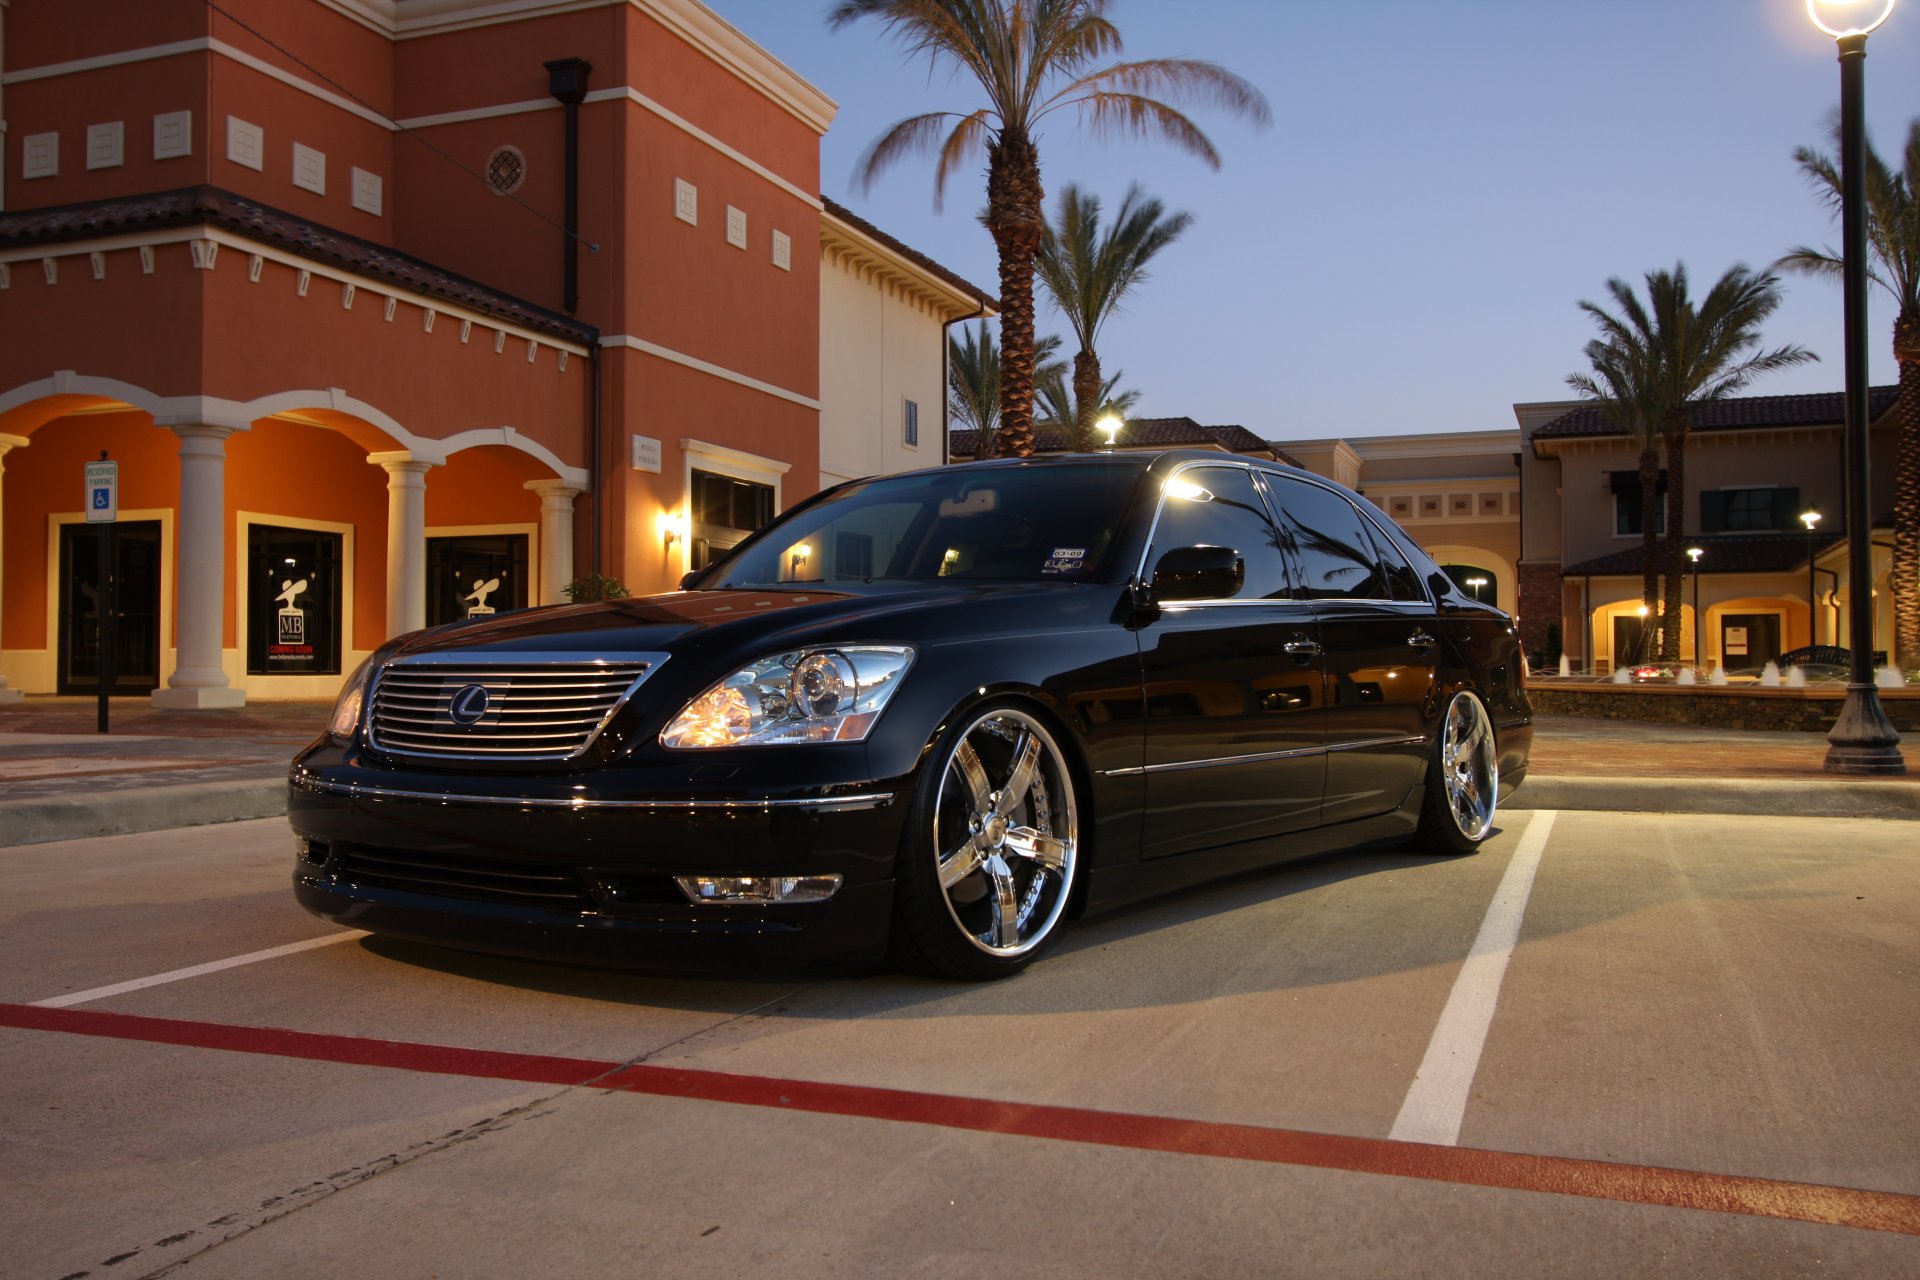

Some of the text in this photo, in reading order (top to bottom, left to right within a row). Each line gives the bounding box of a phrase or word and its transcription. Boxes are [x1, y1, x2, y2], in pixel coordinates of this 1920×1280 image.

[88, 467, 114, 476] RESERVED
[89, 478, 113, 486] PARKING
[281, 617, 302, 634] MB
[270, 645, 313, 653] COMING SOON
